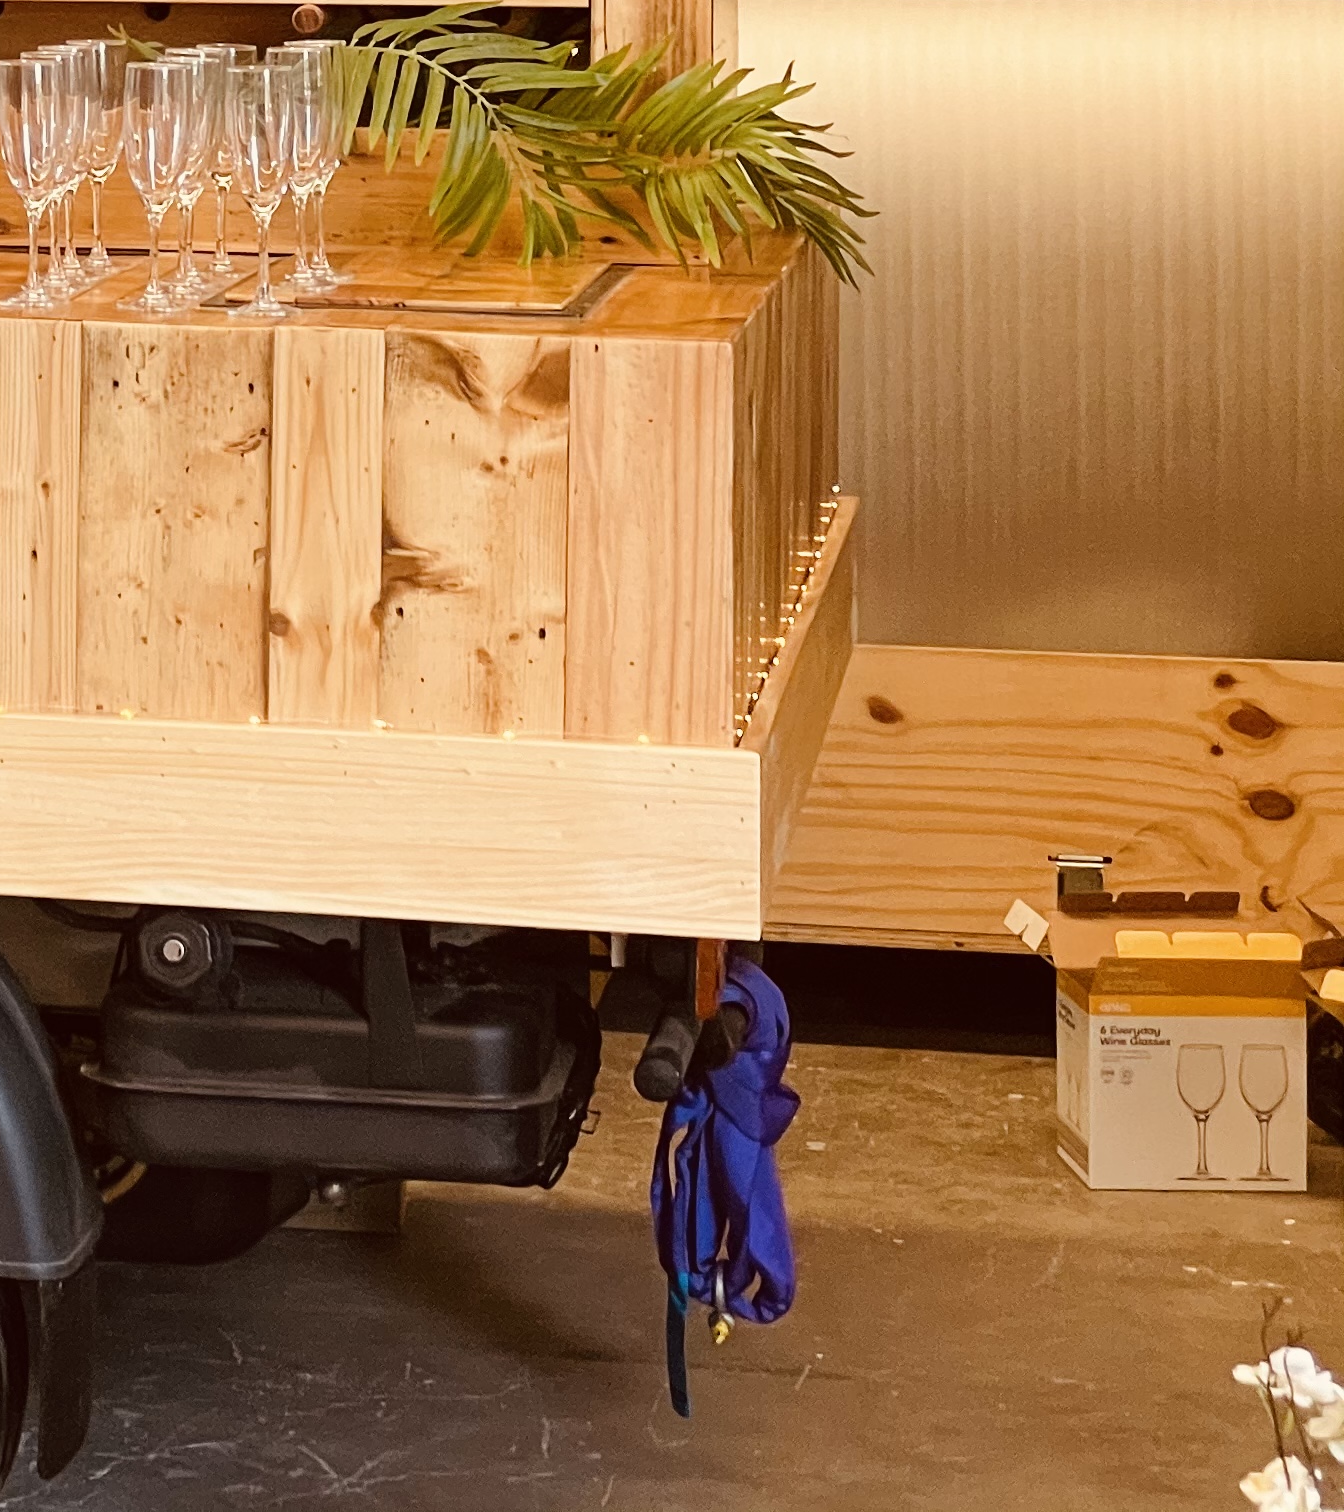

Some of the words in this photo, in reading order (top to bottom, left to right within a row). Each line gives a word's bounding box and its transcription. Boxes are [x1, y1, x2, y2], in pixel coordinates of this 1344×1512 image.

[1110, 1026, 1161, 1039] Everyday
[1100, 1036, 1127, 1046] Wine
[1130, 1036, 1171, 1046] Glasses
